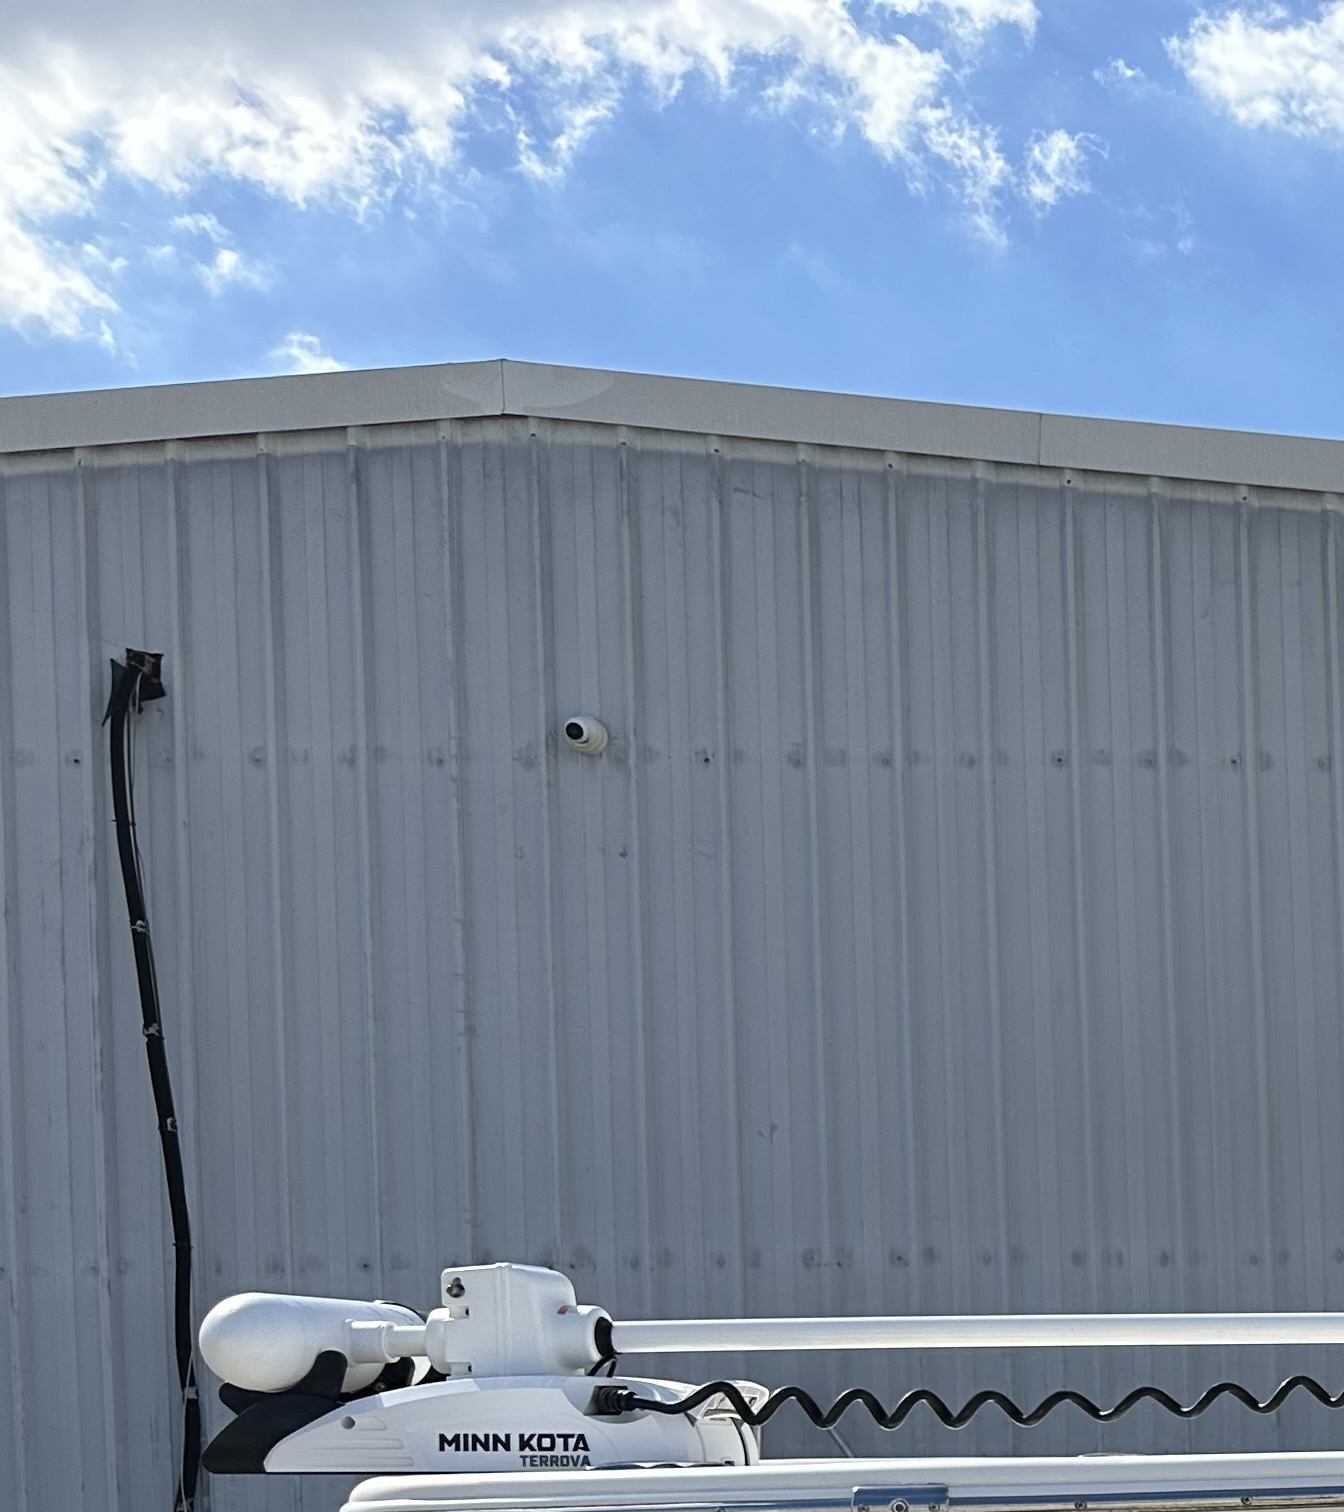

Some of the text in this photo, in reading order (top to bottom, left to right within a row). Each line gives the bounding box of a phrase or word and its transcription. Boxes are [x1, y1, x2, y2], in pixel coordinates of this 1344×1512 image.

[439, 1433, 591, 1452] MINN KOTA
[520, 1454, 591, 1468] TERROVA
